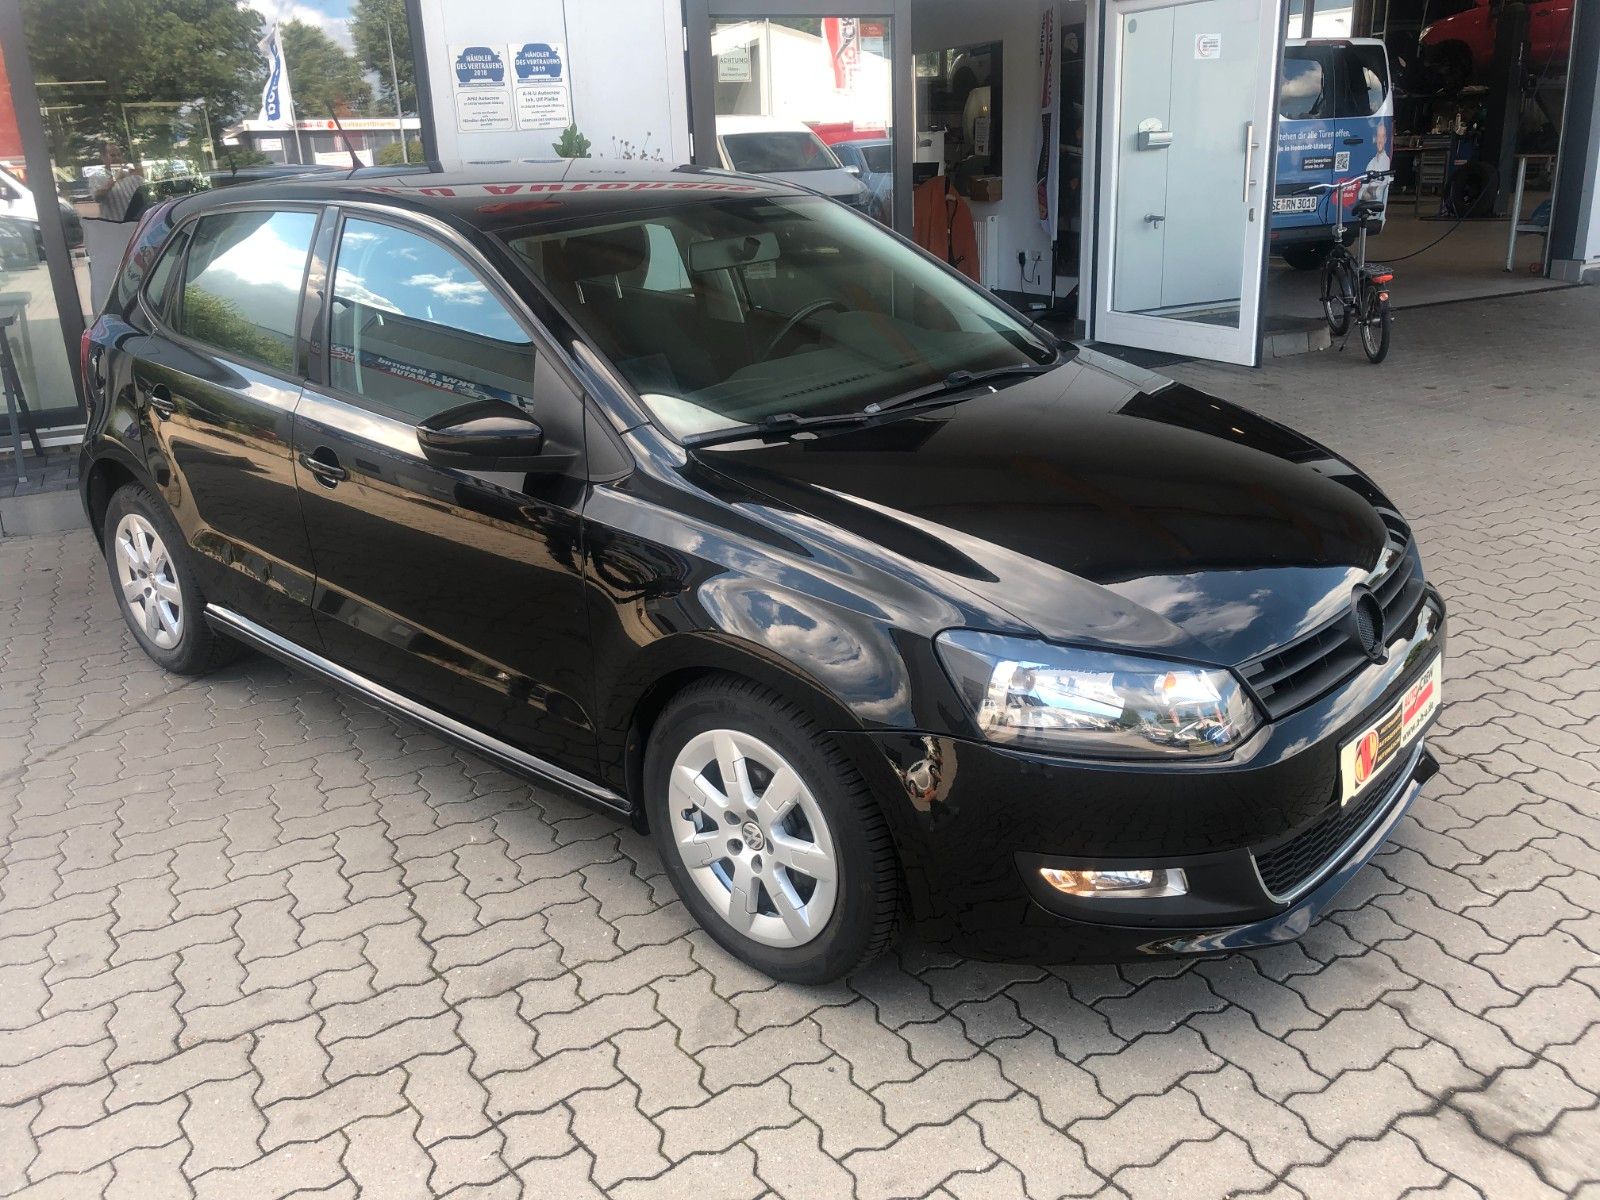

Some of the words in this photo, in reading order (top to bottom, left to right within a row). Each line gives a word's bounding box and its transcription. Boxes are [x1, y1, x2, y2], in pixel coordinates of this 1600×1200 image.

[467, 62, 503, 70] VERTRAUENS
[1279, 132, 1296, 141] tehen
[1286, 199, 1296, 210] RN
[1297, 198, 1316, 209] 3018
